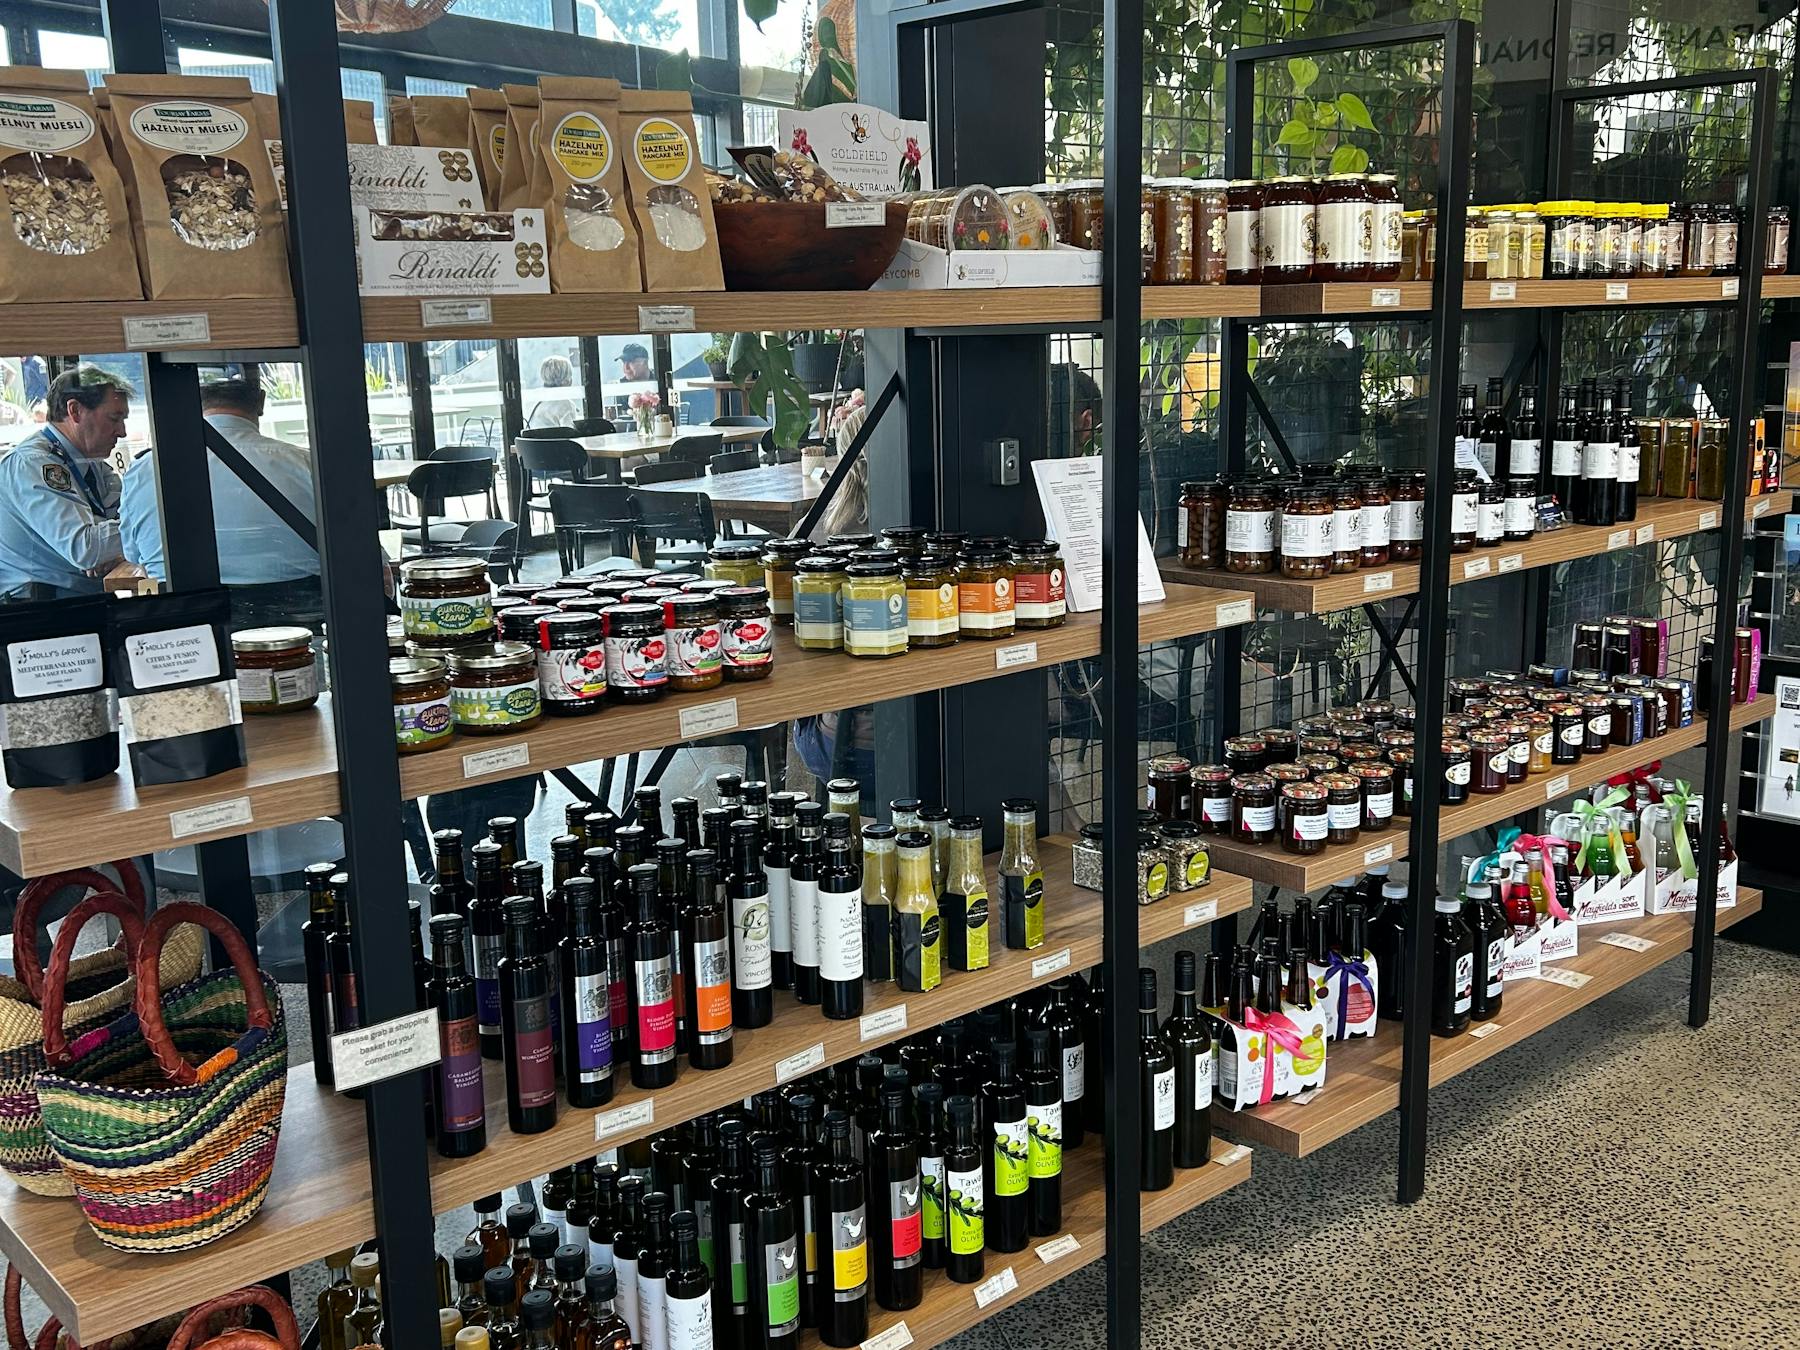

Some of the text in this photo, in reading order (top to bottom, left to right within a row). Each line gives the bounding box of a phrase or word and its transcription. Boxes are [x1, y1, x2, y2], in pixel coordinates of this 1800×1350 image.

[41, 121, 84, 130] MUESLI
[141, 123, 239, 134] HAZELNUT MUESLI
[559, 140, 604, 151] HAZELNUT
[642, 144, 683, 154] HAZELNUT
[560, 148, 589, 157] PANCAKE
[642, 152, 672, 160] PANCAKE
[831, 148, 888, 162] GOLDFIELD
[849, 182, 896, 193] AUSTRALIAN
[389, 249, 502, 280] Rinaldi
[176, 637, 201, 648] GROVE
[61, 646, 87, 656] GROVE
[145, 649, 200, 664] CITRUS FUSION
[1622, 895, 1636, 903] SOFT
[1663, 890, 1697, 908] Mayfie
[1618, 901, 1639, 910] DRINKS
[1502, 956, 1534, 977] ayfields
[342, 1016, 430, 1046] Please grab a shopping
[359, 1032, 415, 1055] basket for your
[364, 1046, 413, 1067] convenience
